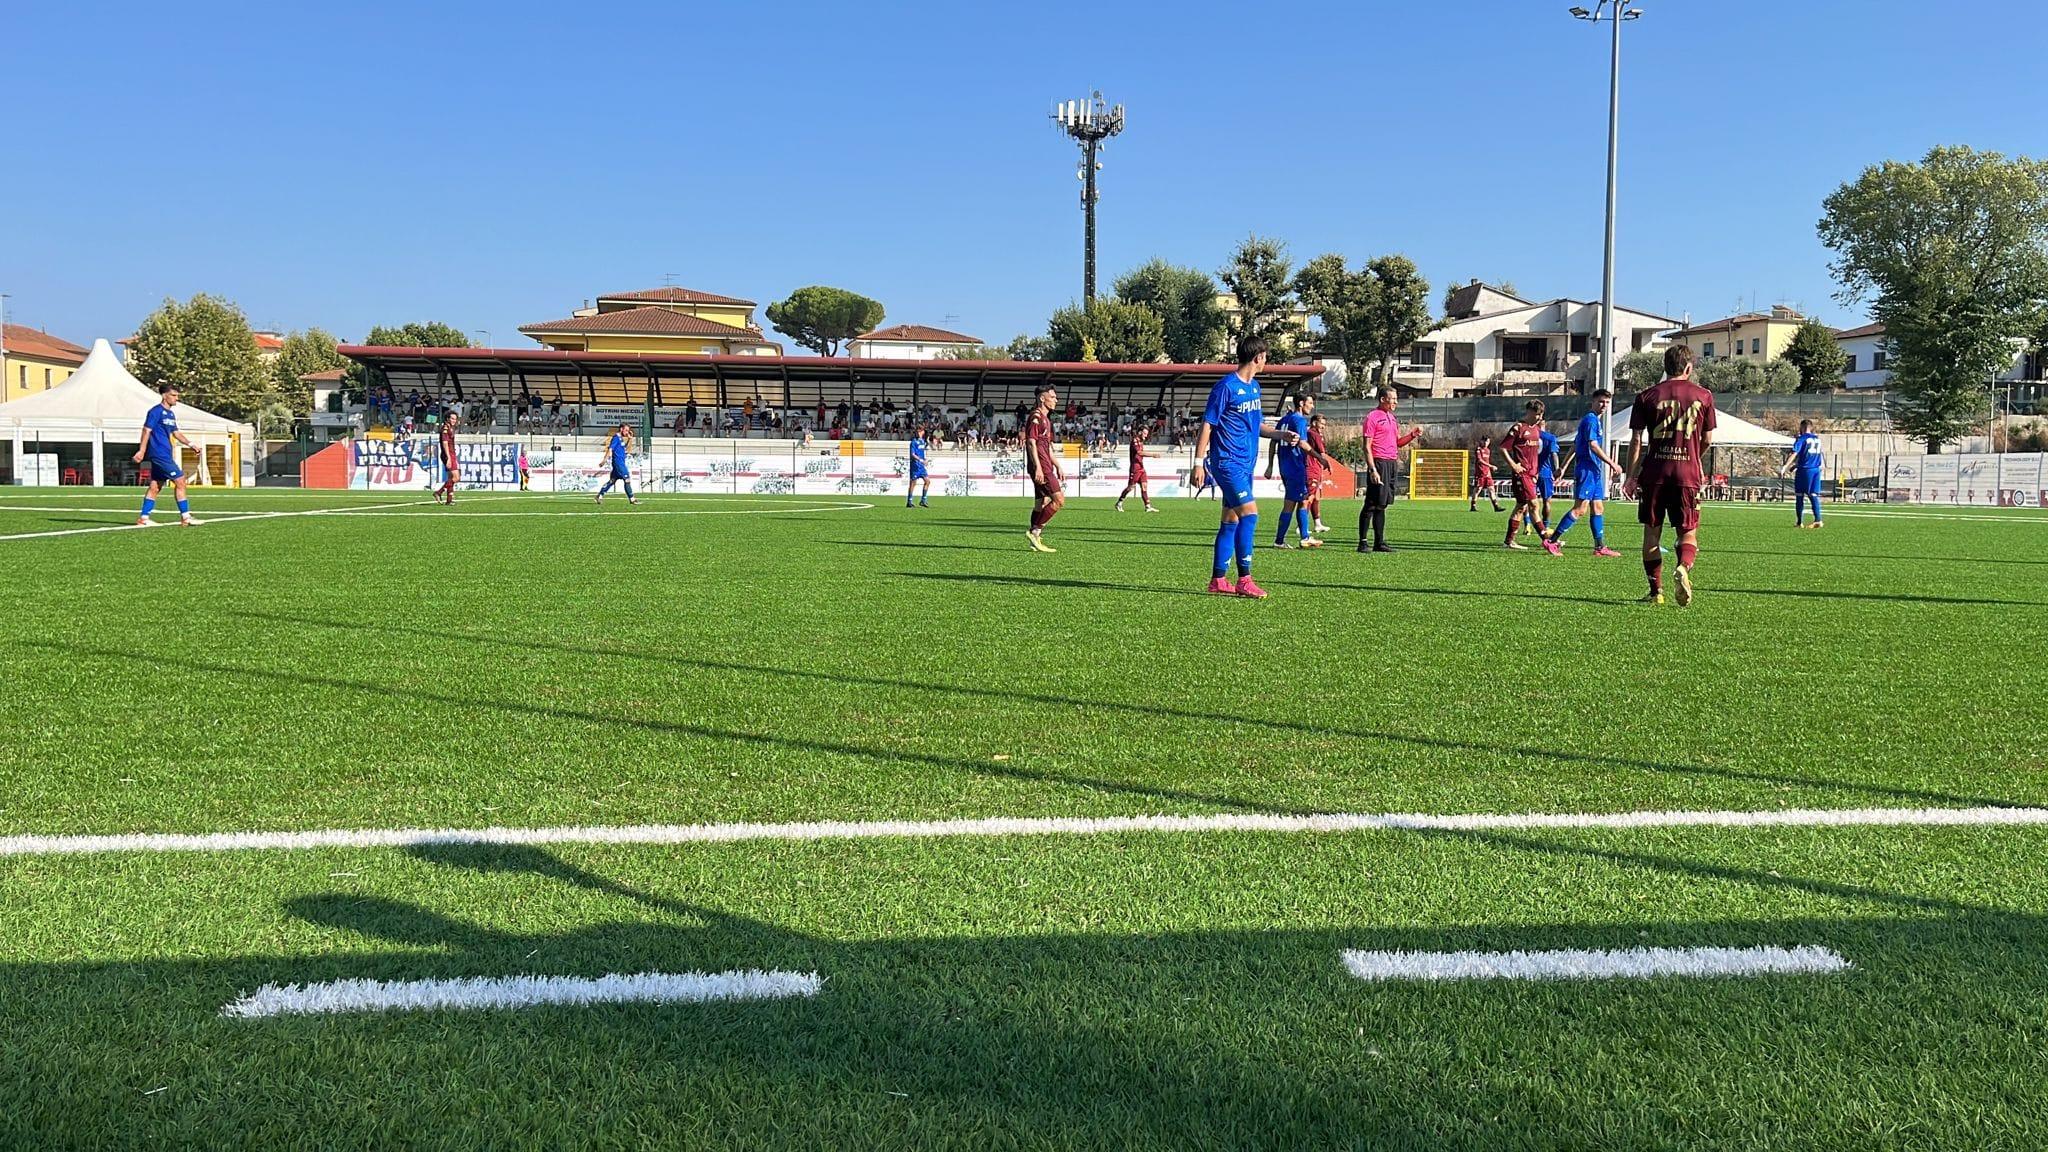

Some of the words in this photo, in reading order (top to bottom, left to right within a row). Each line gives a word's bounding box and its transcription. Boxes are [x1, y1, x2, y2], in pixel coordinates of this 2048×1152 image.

[1652, 399, 1702, 440] 24
[358, 455, 408, 467] PRATO
[458, 463, 514, 482] LTRAS
